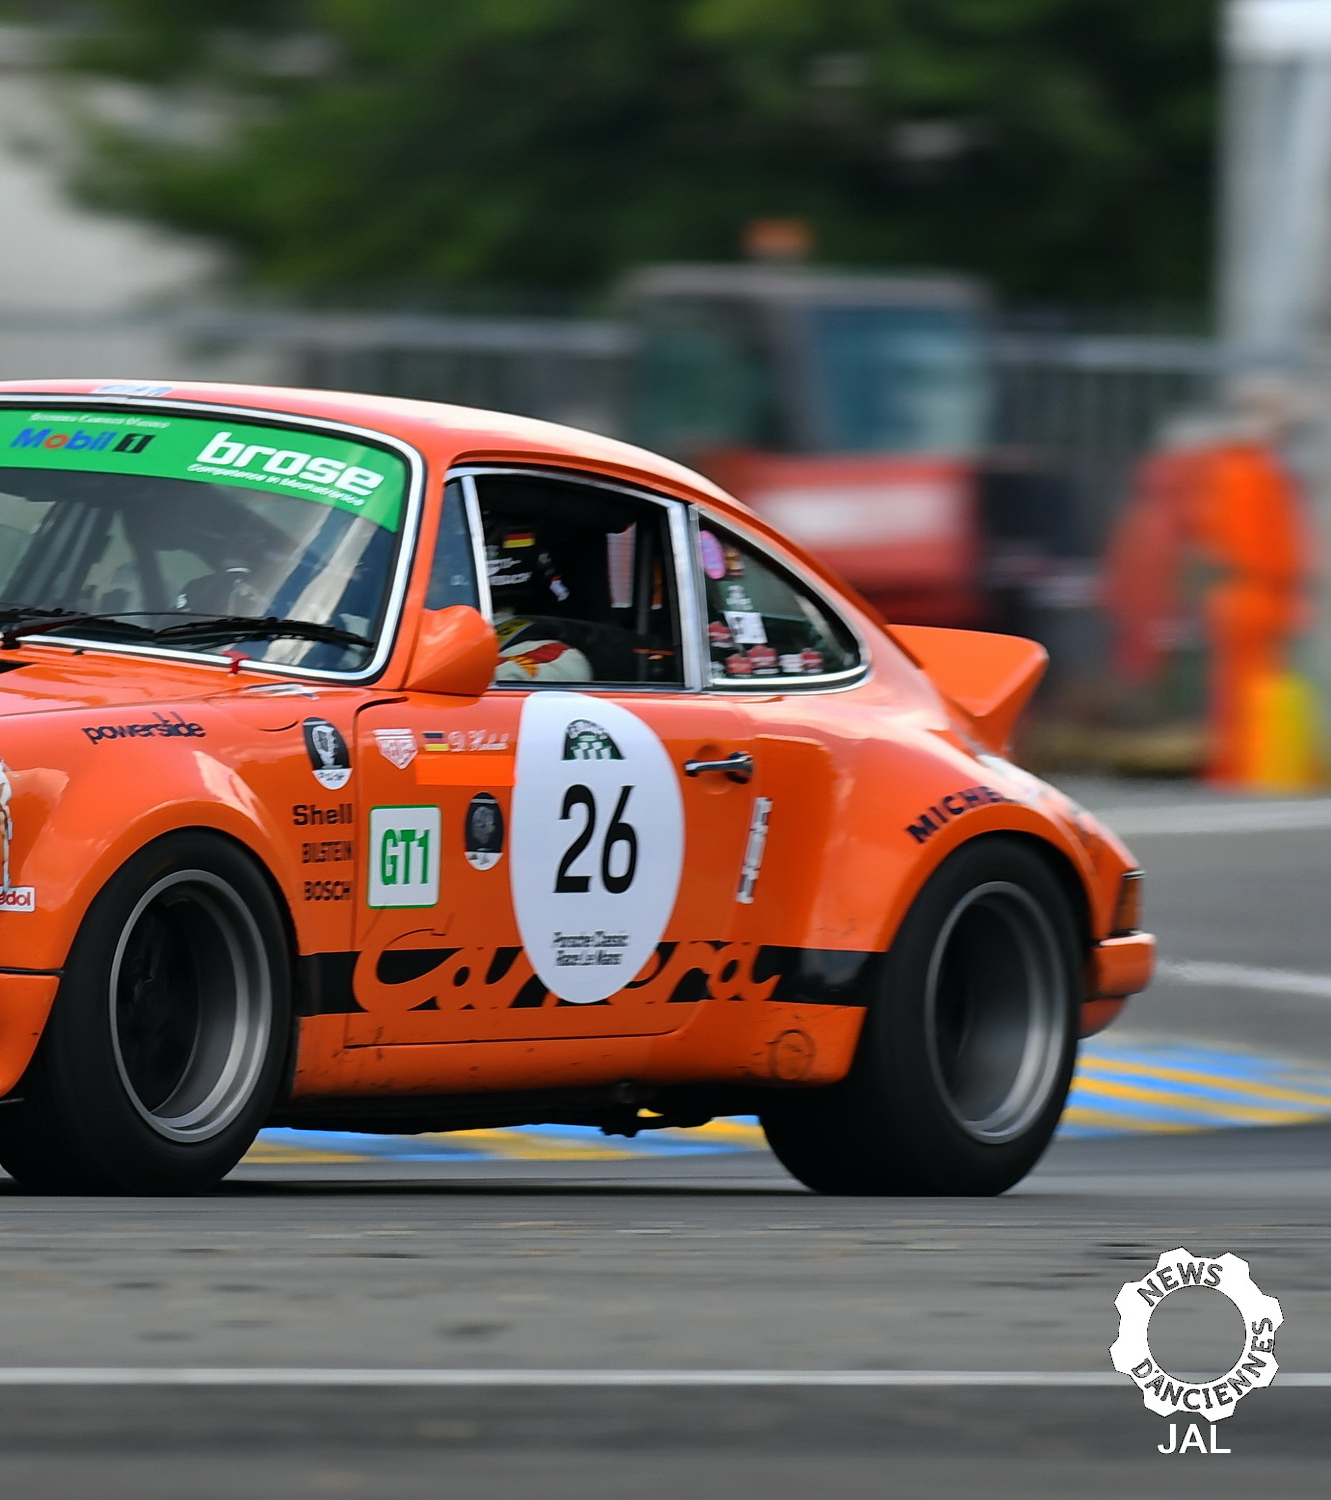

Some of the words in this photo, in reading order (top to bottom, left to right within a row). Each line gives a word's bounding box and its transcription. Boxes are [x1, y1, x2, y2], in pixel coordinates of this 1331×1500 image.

[10, 428, 117, 451] Mobil
[196, 431, 384, 496] brose
[292, 803, 353, 826] Shell
[380, 828, 430, 886] GT1
[553, 784, 638, 894] 26
[304, 881, 352, 901] BOSCH
